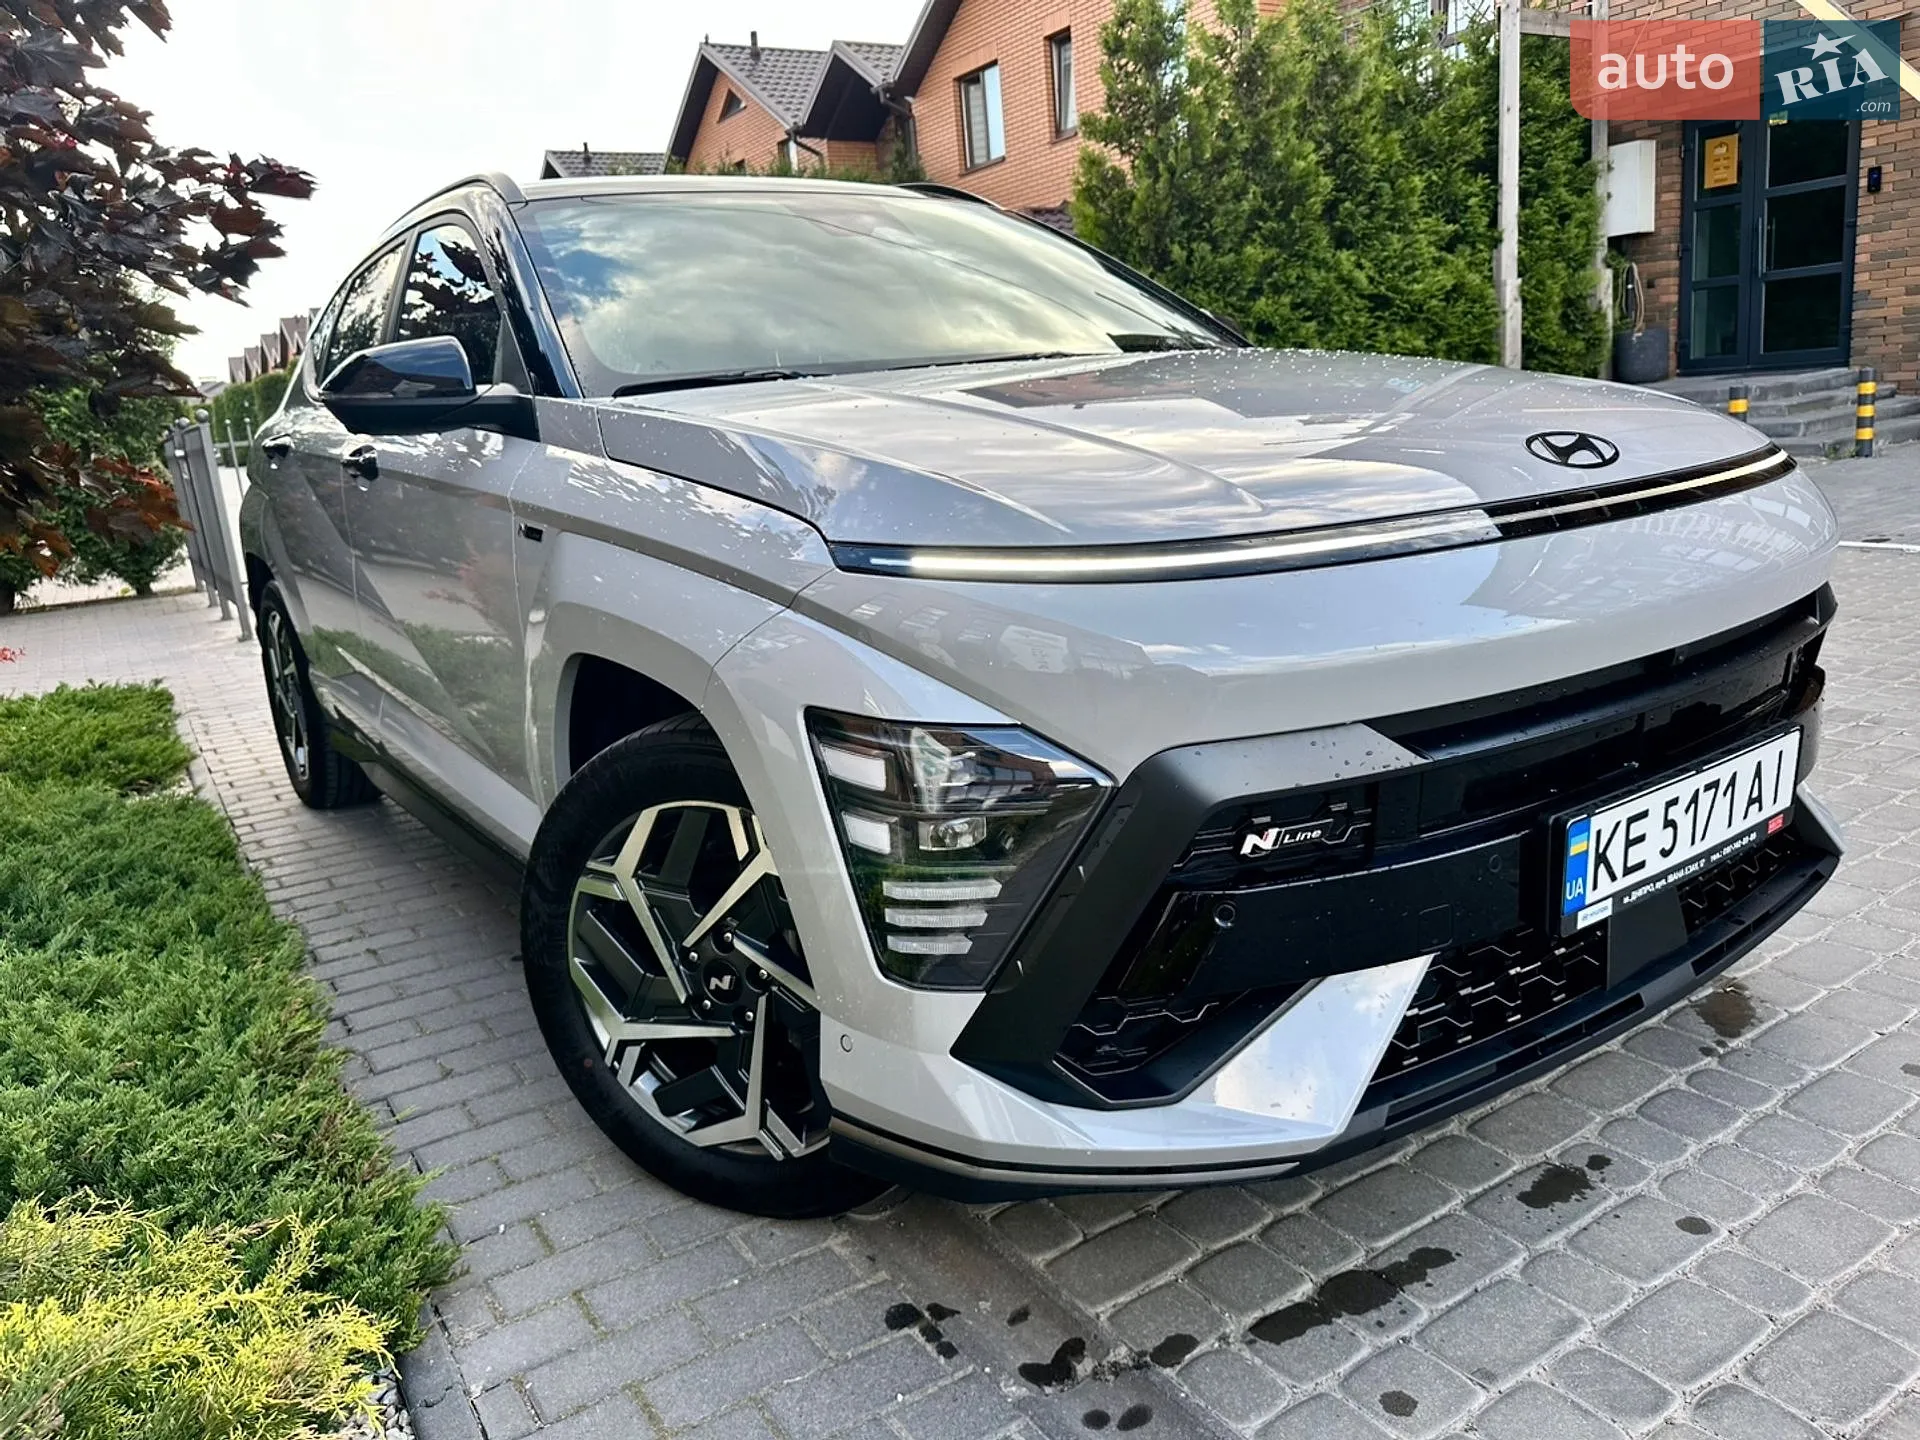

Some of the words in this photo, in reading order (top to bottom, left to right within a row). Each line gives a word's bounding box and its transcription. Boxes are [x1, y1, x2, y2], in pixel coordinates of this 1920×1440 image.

[1592, 809, 1650, 892] KE
[1659, 771, 1738, 858] 5171
[1743, 750, 1784, 820] AI
[1240, 827, 1280, 855] N
[1284, 829, 1322, 844] Line
[1566, 877, 1584, 900] UA
